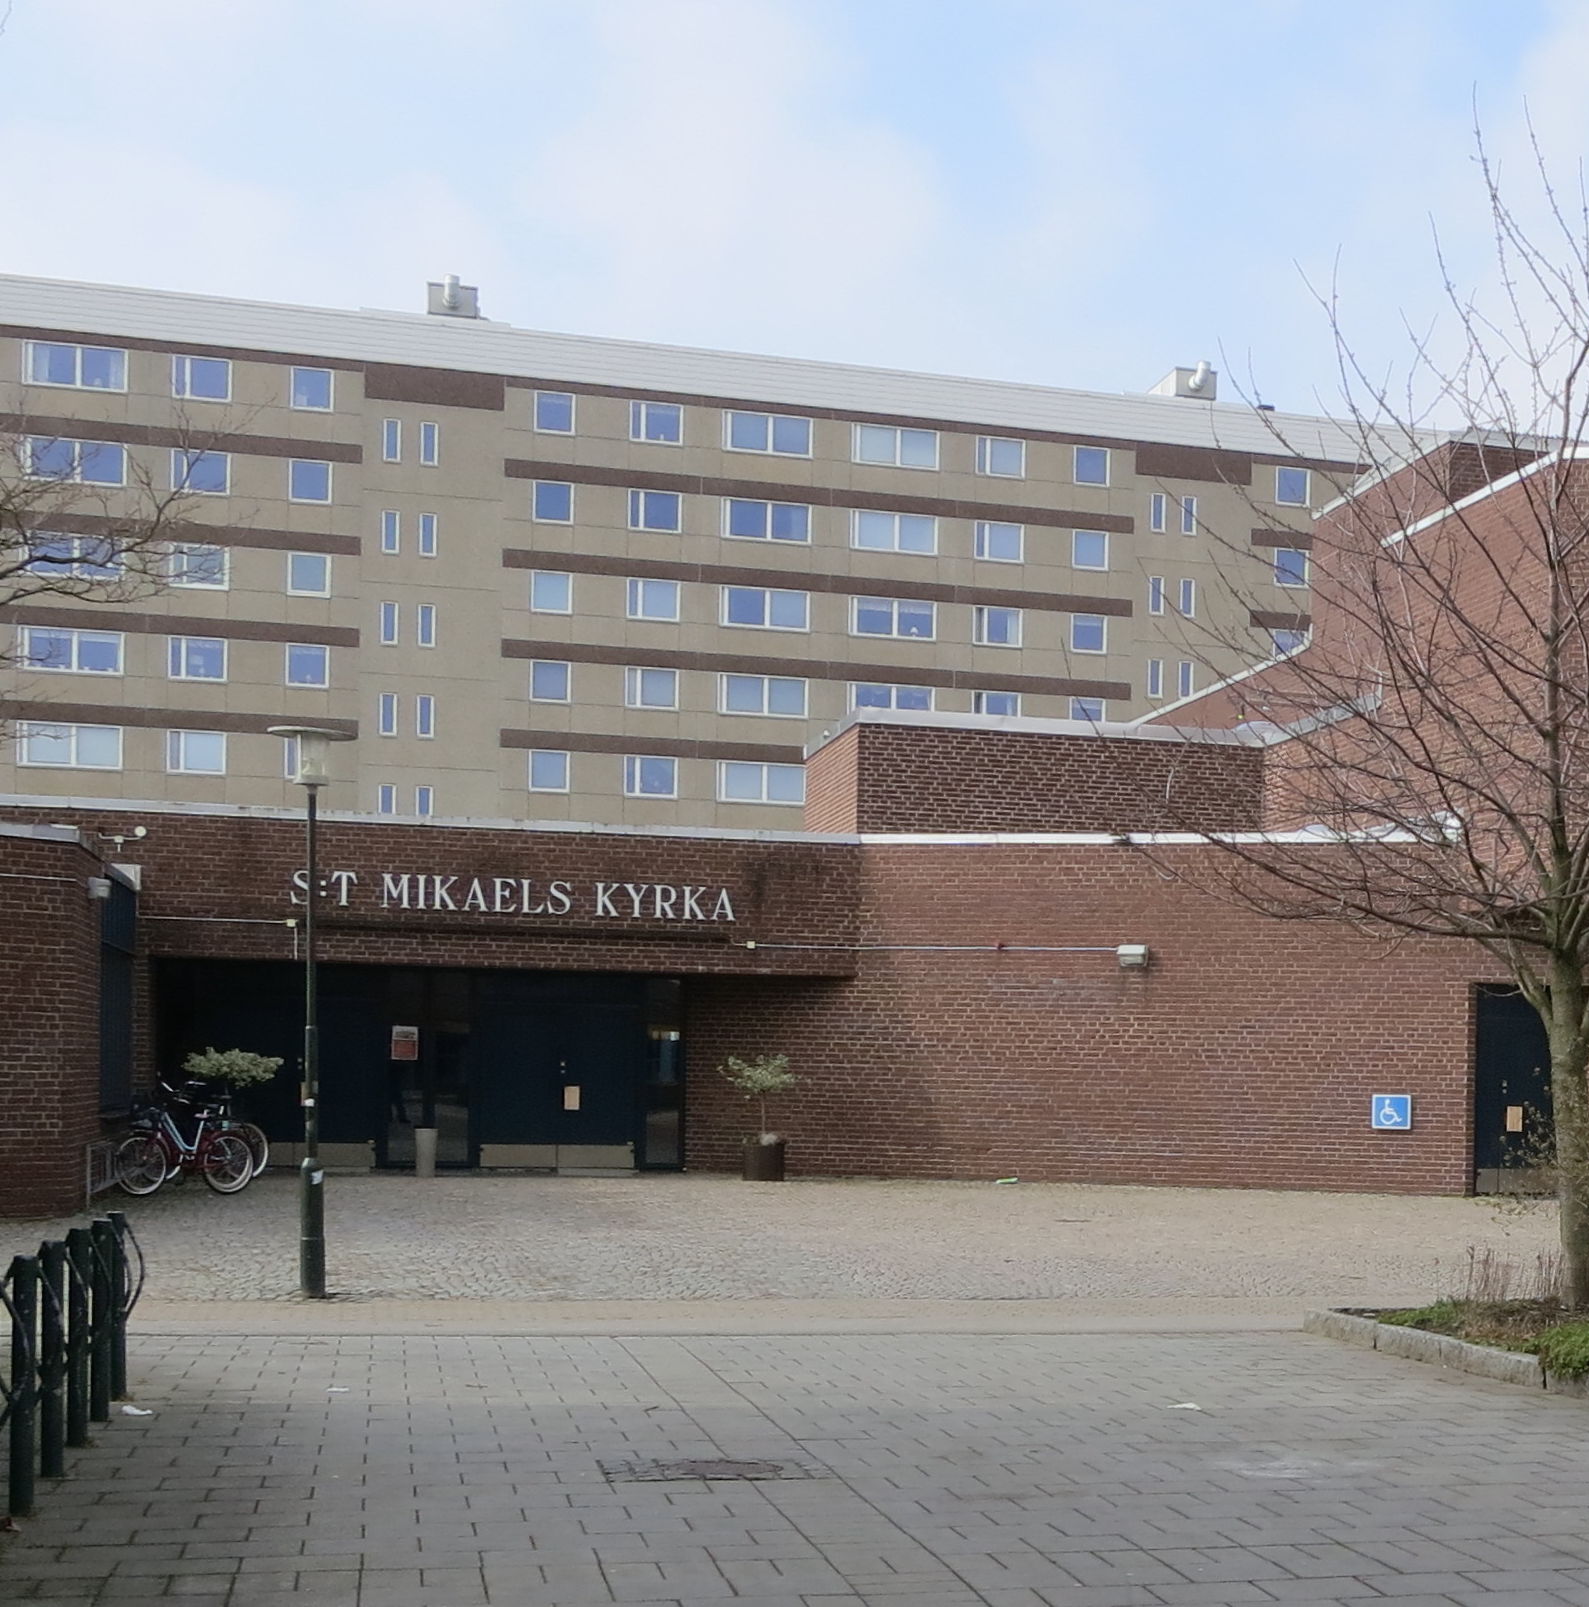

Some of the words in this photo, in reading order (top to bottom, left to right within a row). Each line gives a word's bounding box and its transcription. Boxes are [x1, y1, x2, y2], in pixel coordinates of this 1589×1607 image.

[290, 870, 358, 907] S:T
[380, 873, 572, 915] MIKAELS
[595, 882, 736, 922] KYRKA
